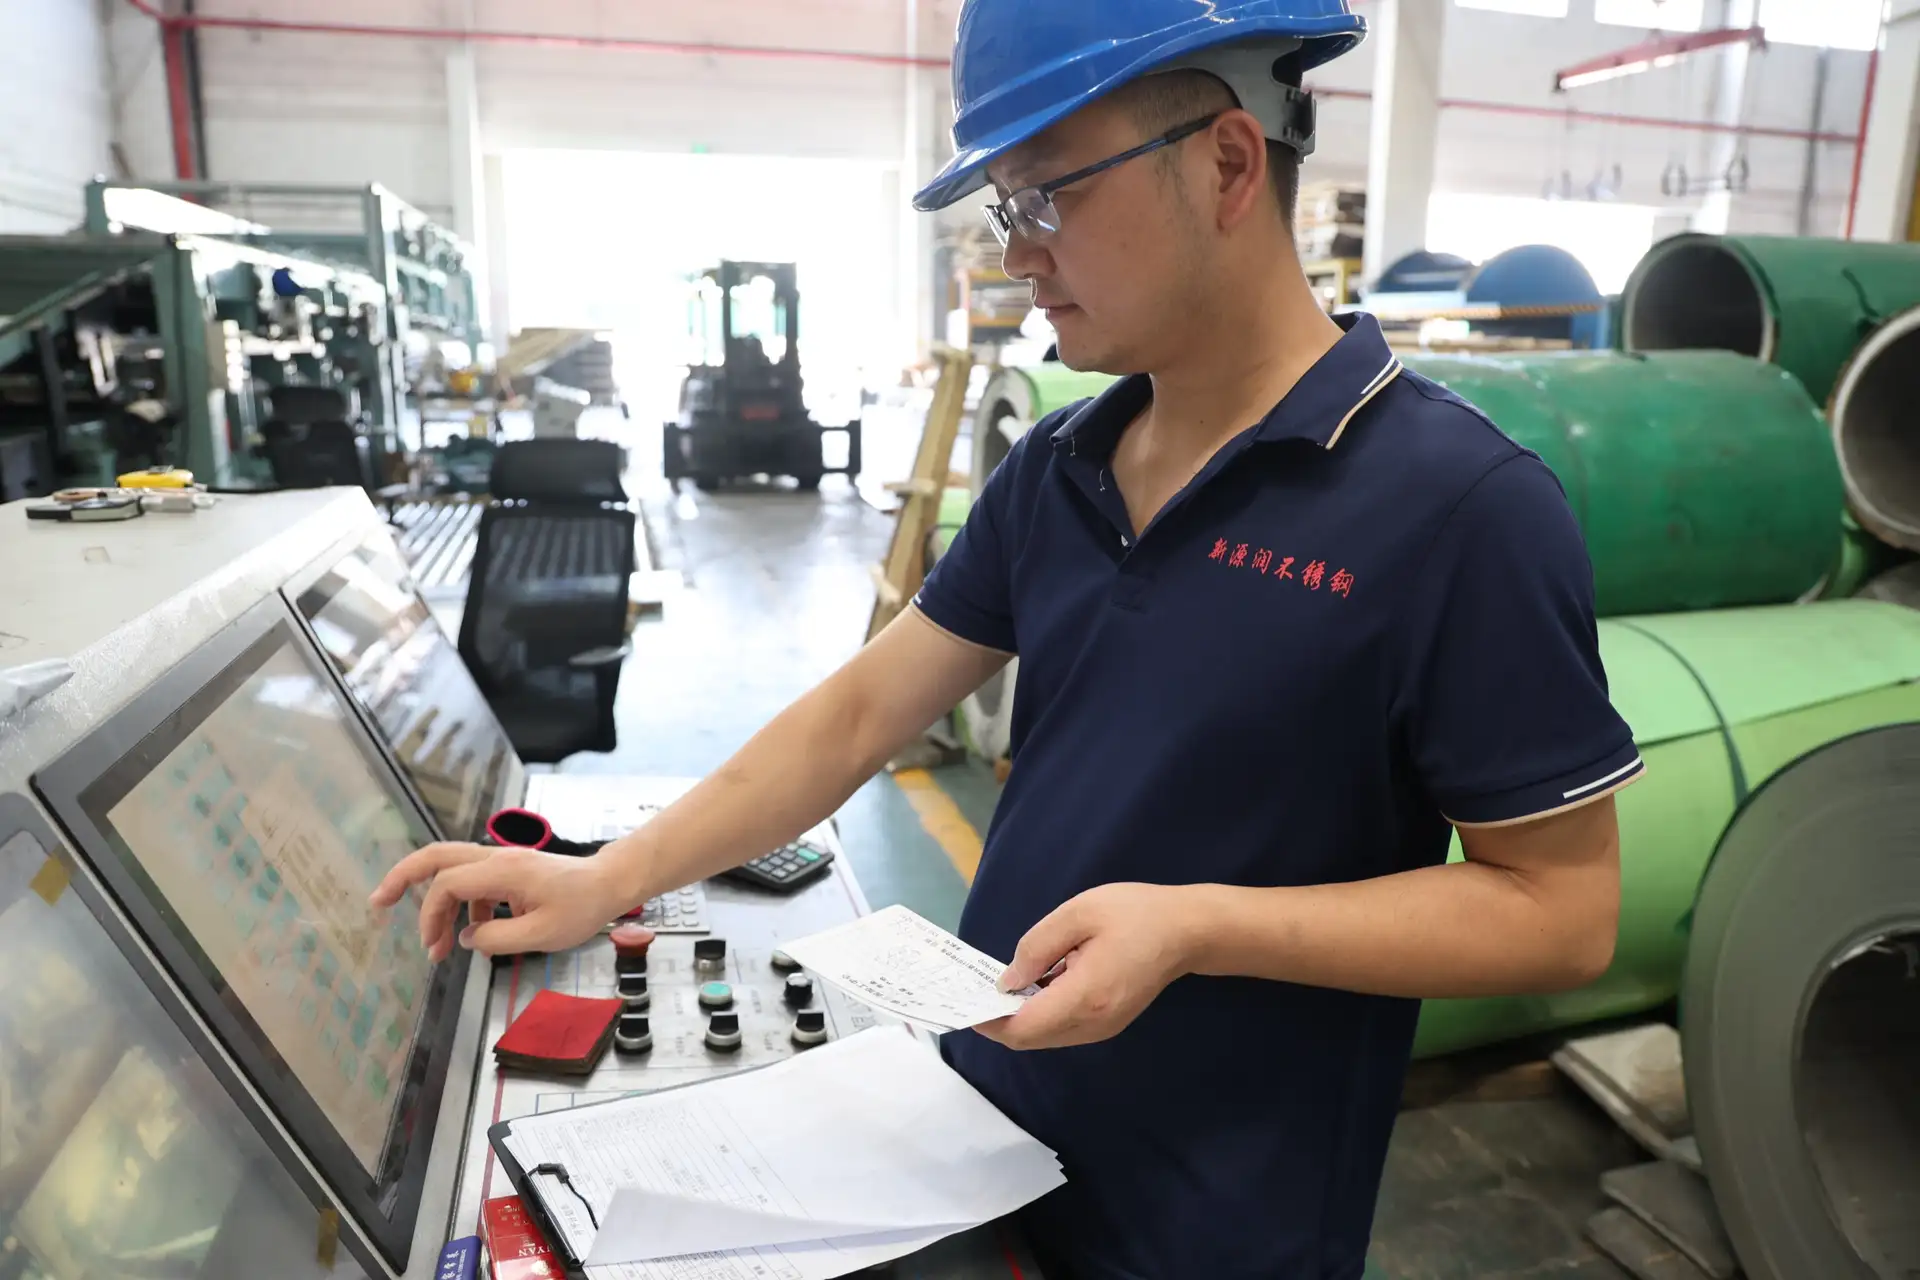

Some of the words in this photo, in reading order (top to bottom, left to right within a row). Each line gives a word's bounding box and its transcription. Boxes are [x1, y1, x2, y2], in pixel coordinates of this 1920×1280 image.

[1208, 537, 1354, 599] 新源润不锈钢
